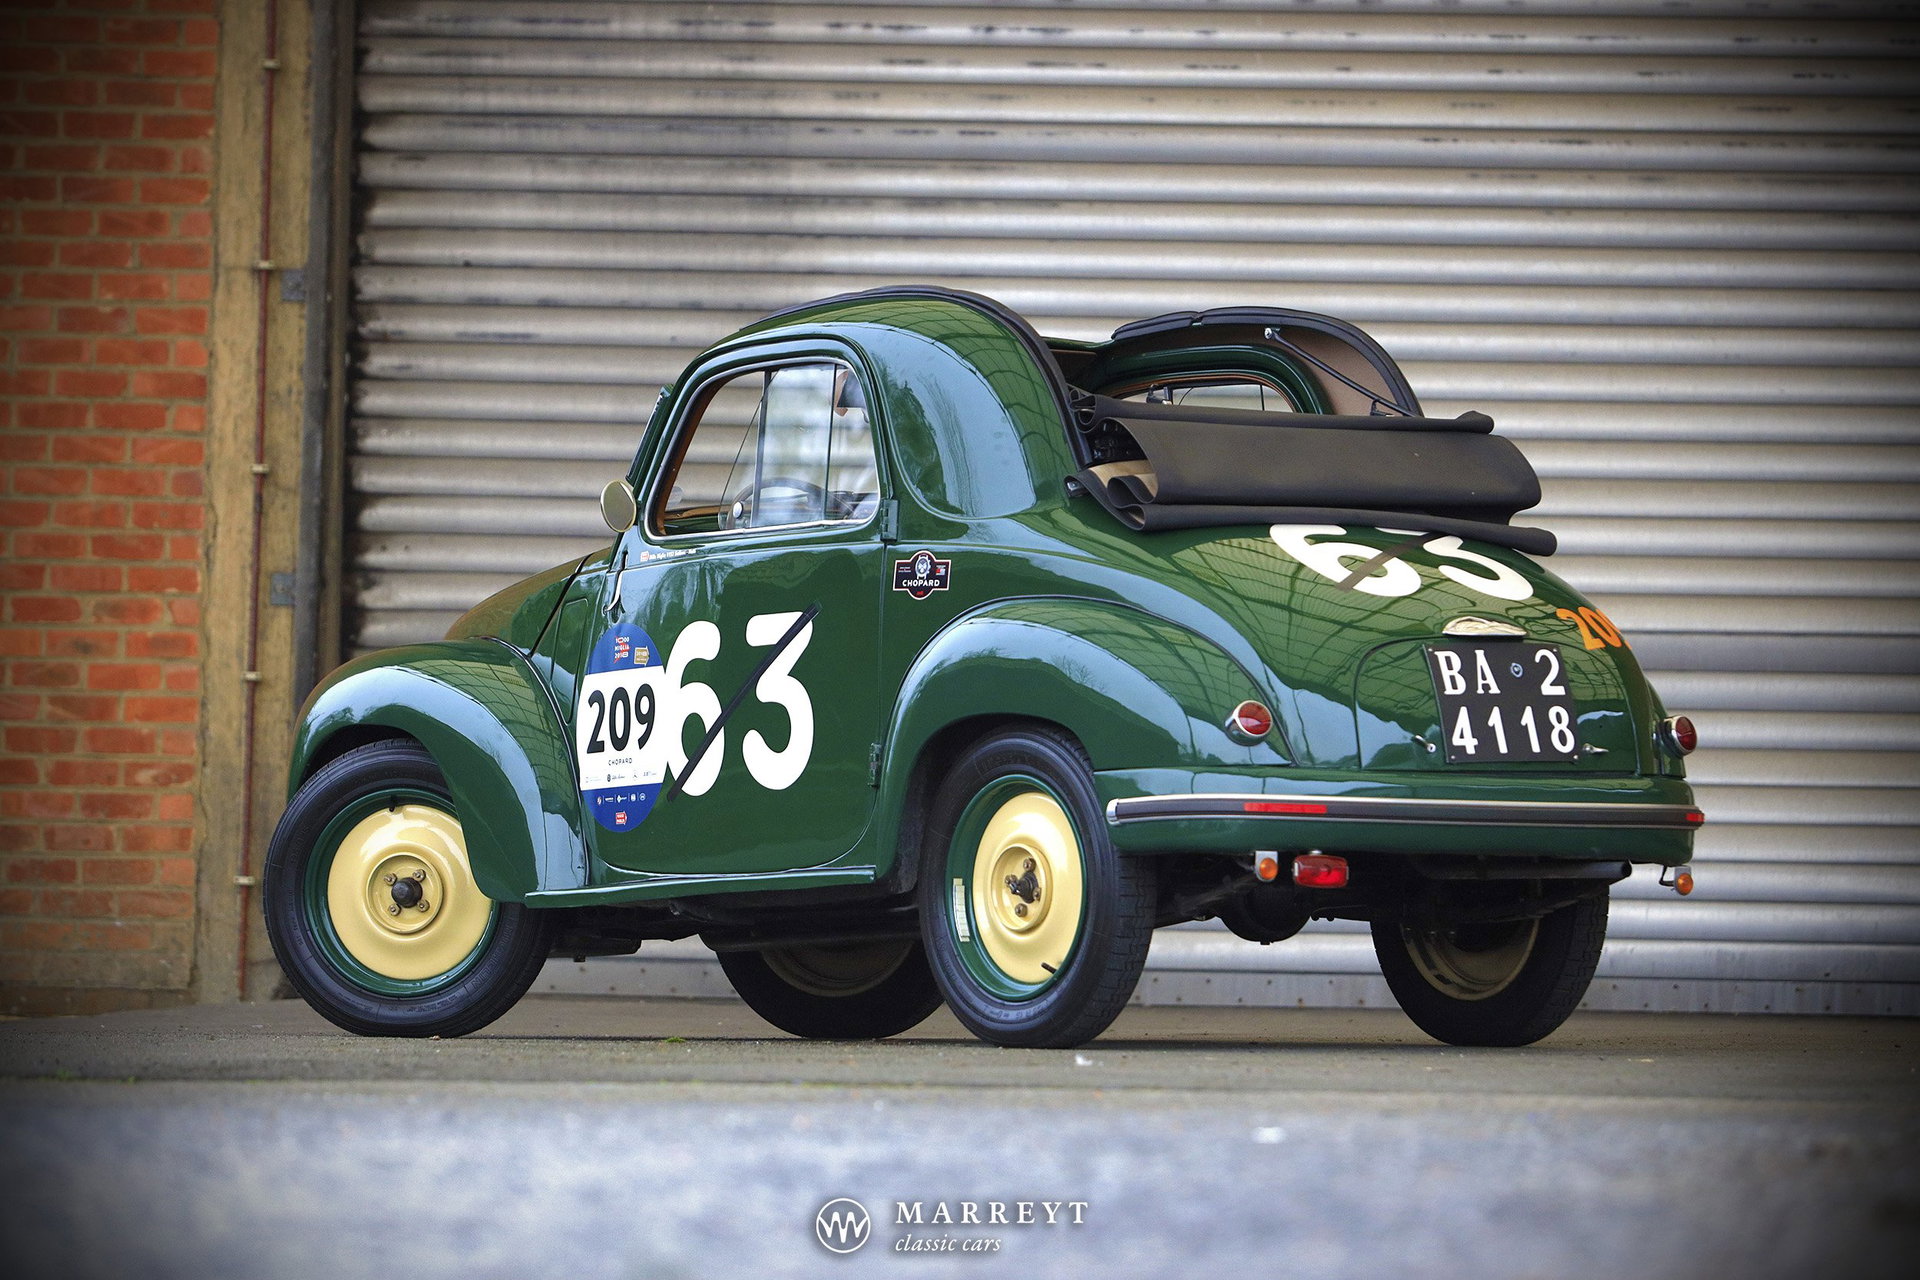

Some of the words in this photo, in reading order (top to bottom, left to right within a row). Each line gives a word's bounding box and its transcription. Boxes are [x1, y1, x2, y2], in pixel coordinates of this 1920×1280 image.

[902, 579, 940, 587] CHOPARD
[1269, 524, 1534, 601] 63
[1556, 606, 1633, 651] 20
[1434, 649, 1501, 696] BA
[1534, 649, 1566, 696] 2
[586, 683, 656, 754] 209
[665, 611, 814, 797] 63
[1451, 705, 1575, 754] 4118
[608, 757, 633, 766] CHOPARD
